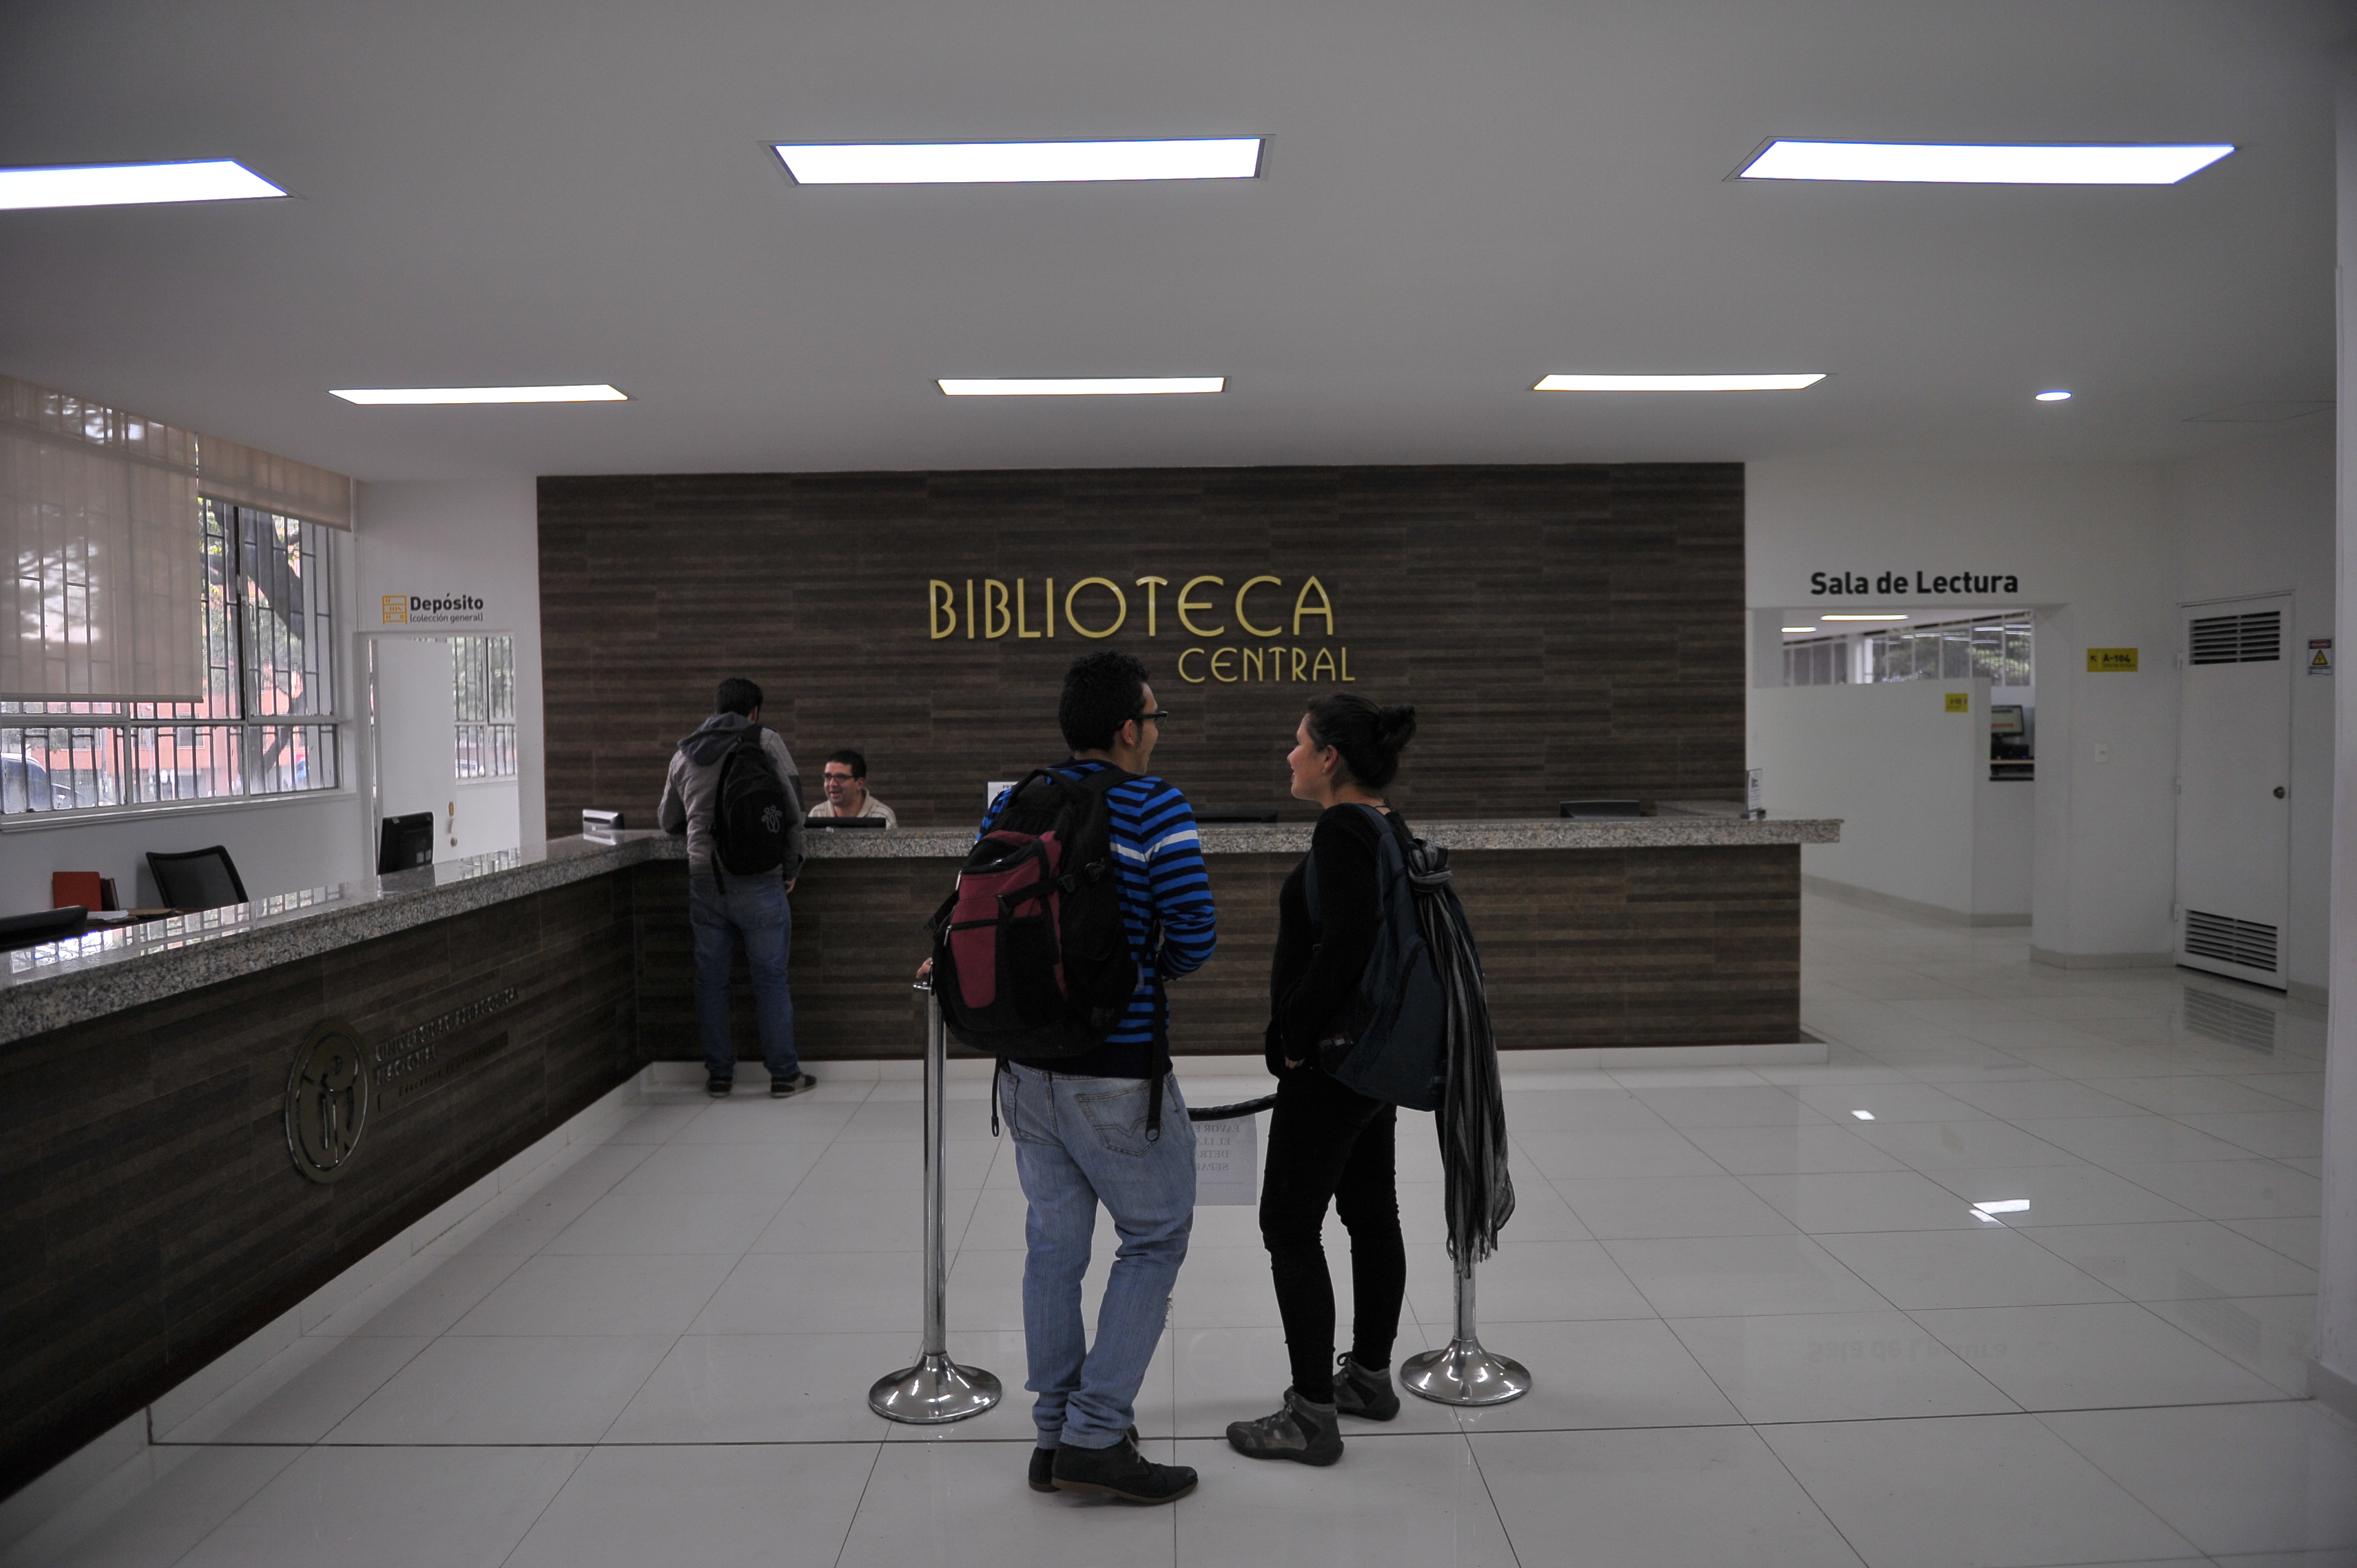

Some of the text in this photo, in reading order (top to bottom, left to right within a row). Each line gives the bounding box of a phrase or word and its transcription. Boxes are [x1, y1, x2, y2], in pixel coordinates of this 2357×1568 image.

[1810, 571, 2019, 595] Sala de Lectura
[410, 592, 484, 614] Depósito
[929, 575, 1334, 639] BIBLIOTECA
[1177, 646, 1356, 683] CENTRAL
[2103, 653, 2130, 663] A-104
